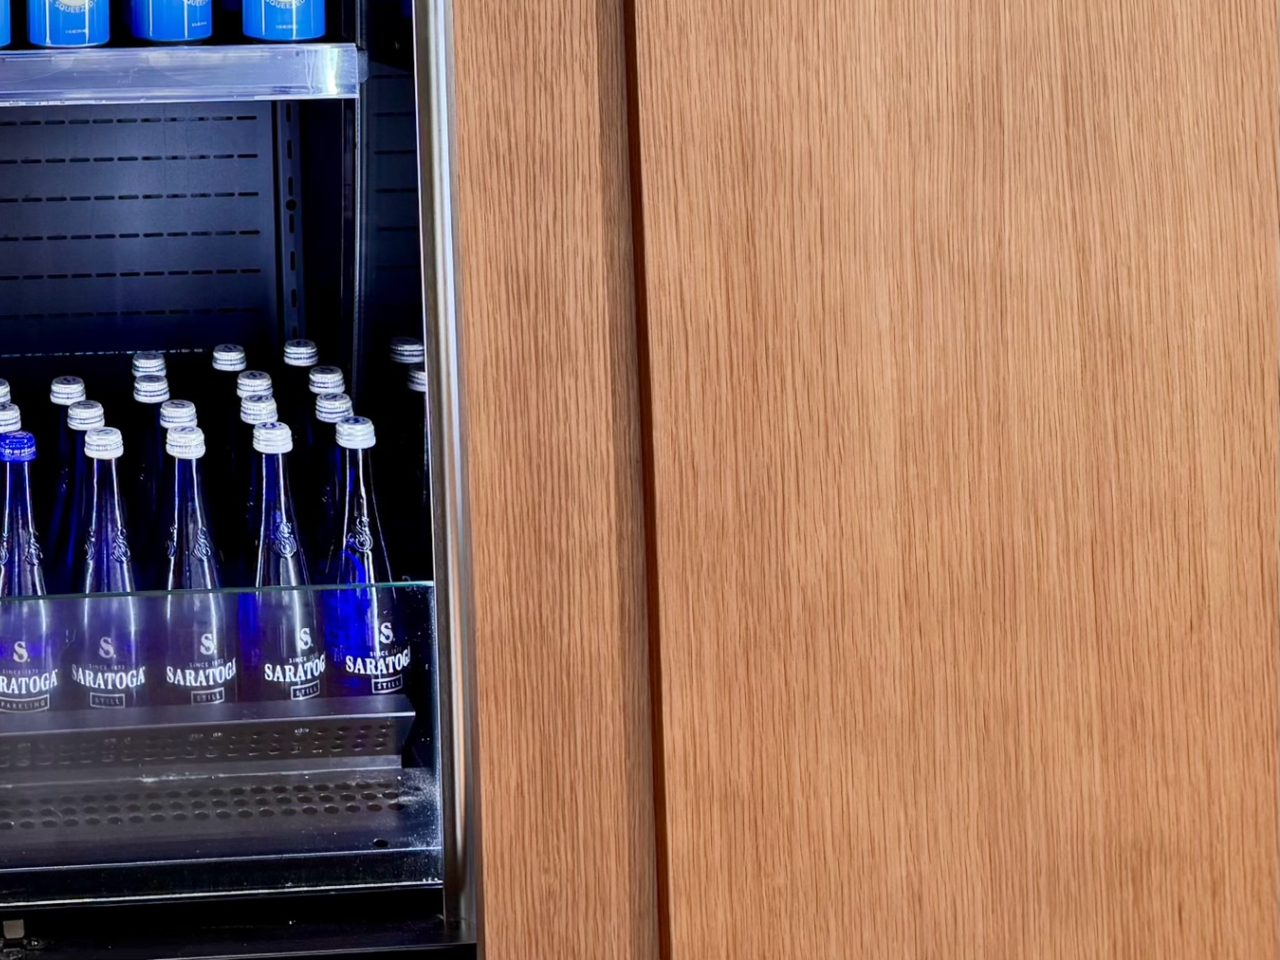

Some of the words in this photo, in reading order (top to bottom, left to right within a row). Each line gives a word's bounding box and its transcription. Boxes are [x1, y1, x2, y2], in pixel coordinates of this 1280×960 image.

[72, 663, 145, 689] SARATOGA
[264, 652, 326, 682] SARATOG
[296, 686, 317, 696] STILL
[377, 681, 400, 690] STILL
